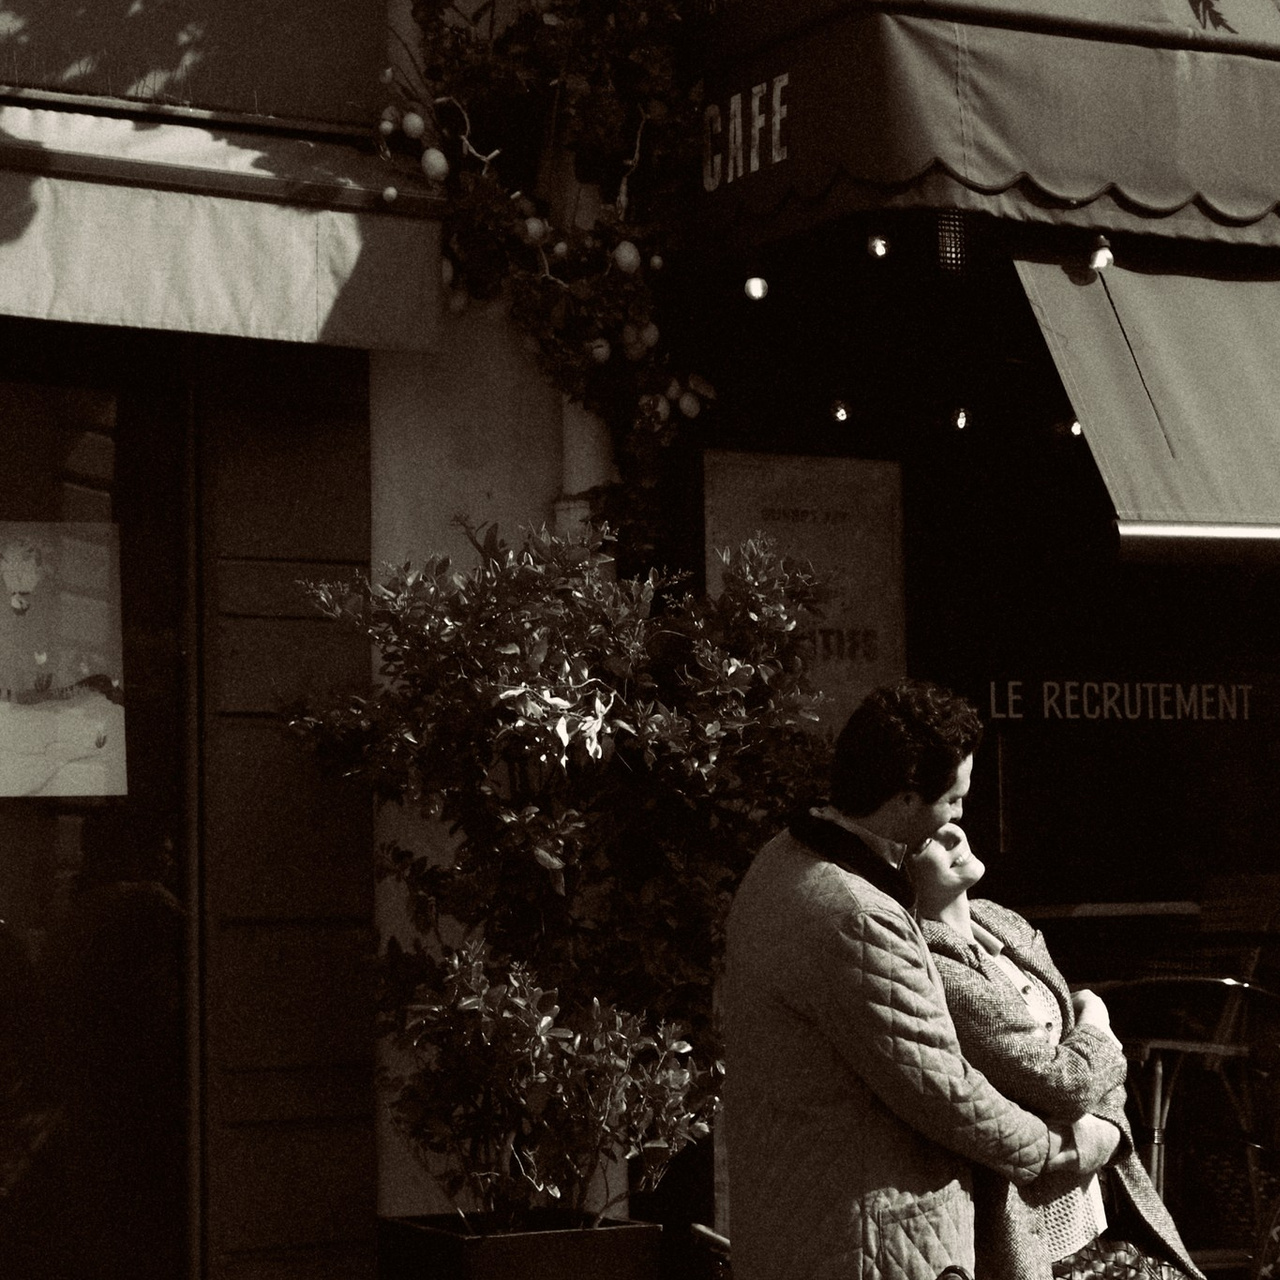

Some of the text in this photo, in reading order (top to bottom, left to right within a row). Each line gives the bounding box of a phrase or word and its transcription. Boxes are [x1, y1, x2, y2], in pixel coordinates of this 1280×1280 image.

[703, 72, 789, 193] CAFE
[989, 680, 1252, 720] LE RECRUTEMENT
